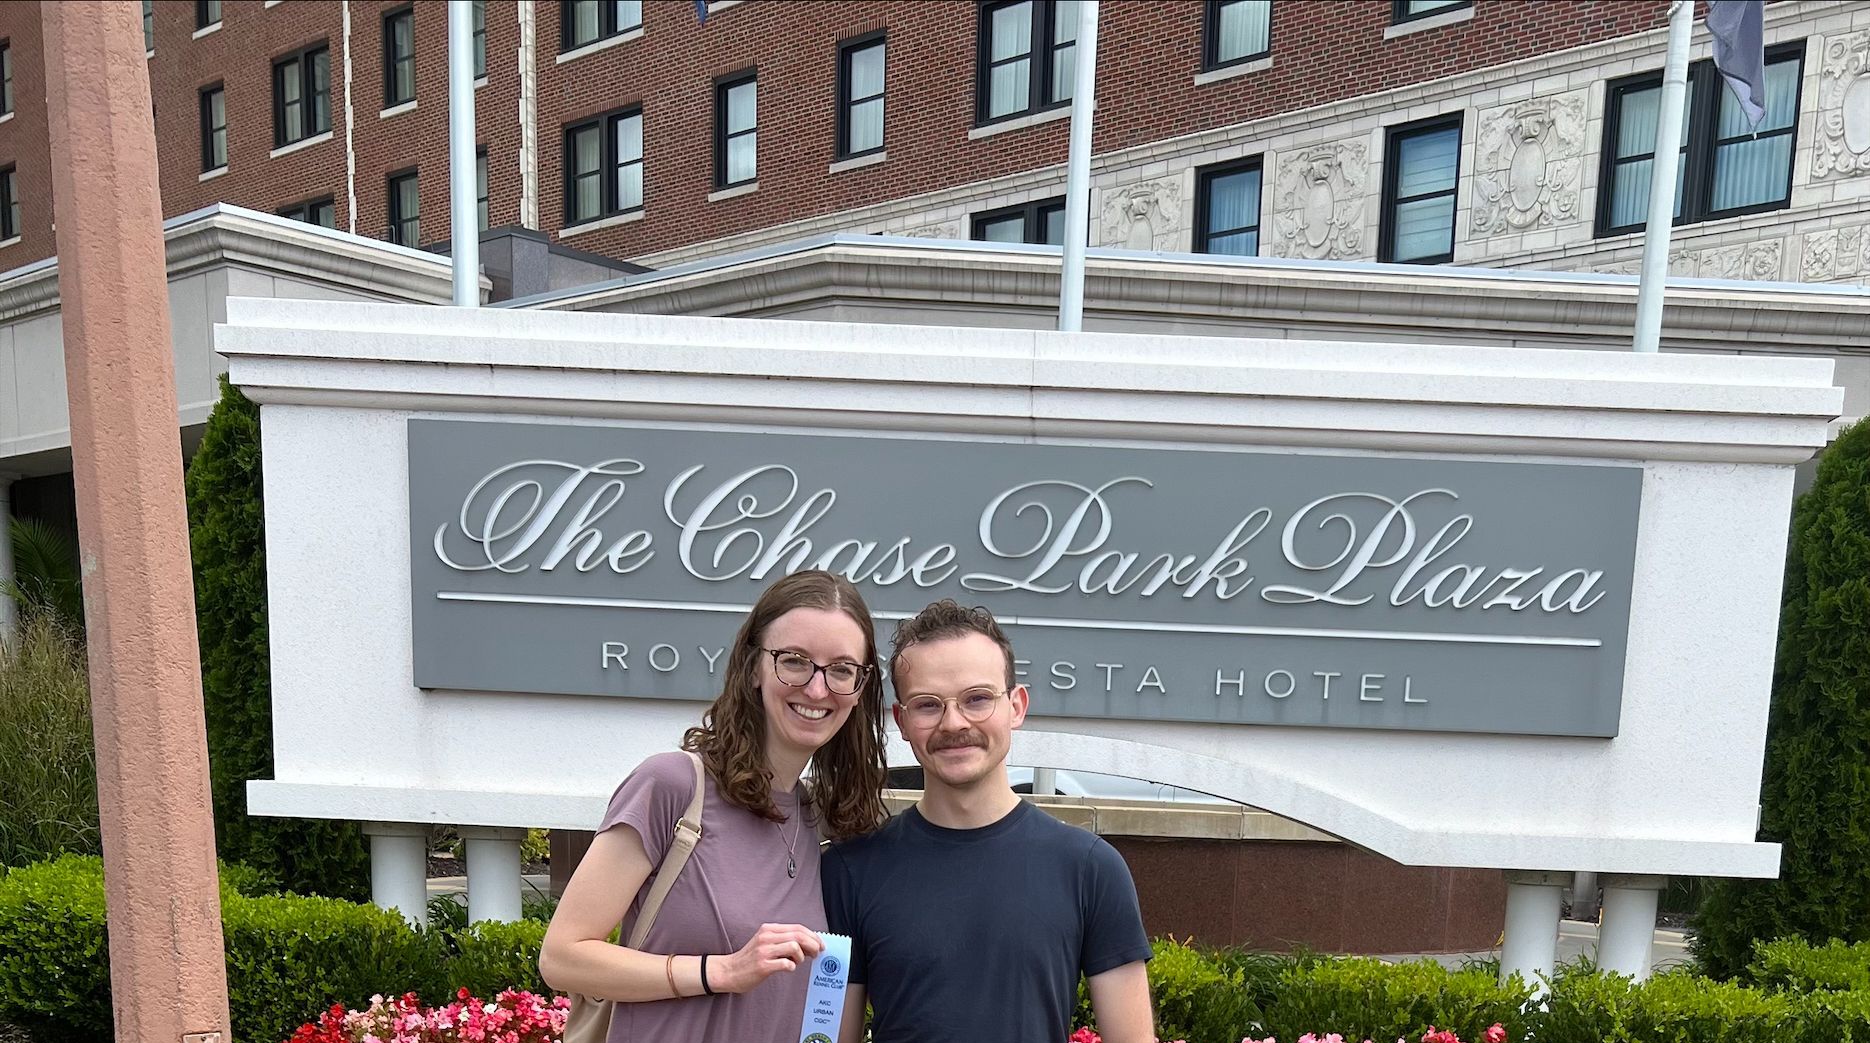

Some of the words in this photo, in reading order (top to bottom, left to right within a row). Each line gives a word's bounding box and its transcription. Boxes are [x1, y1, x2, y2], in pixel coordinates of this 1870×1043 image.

[433, 457, 656, 574] The
[663, 463, 960, 588] Chase
[960, 475, 1273, 602] Park
[1261, 487, 1608, 615] Plaza
[601, 640, 725, 675] ROY
[1214, 667, 1429, 704] HOTEL
[815, 975, 844, 985] AMERICAN
